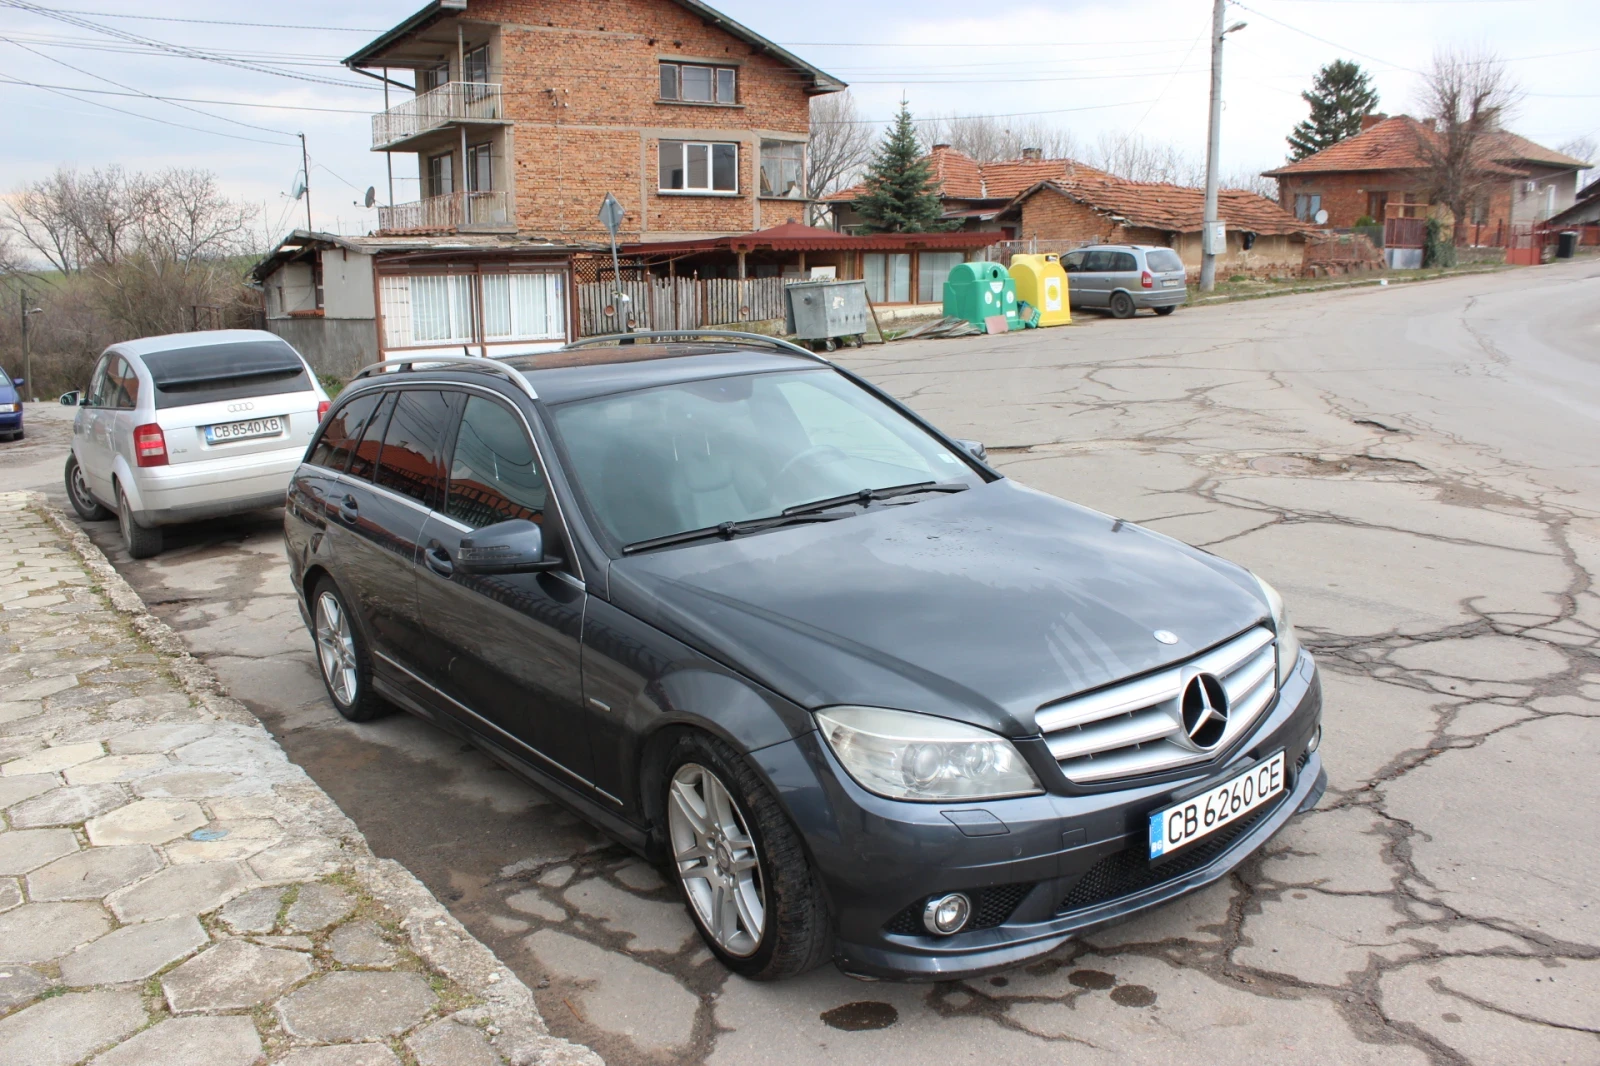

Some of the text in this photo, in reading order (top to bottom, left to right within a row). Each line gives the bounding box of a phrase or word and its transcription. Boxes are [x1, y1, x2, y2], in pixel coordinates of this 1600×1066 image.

[214, 418, 279, 438] CB 8540 KB
[1168, 758, 1280, 844] CB 6260 CE
[1151, 840, 1163, 852] BG
